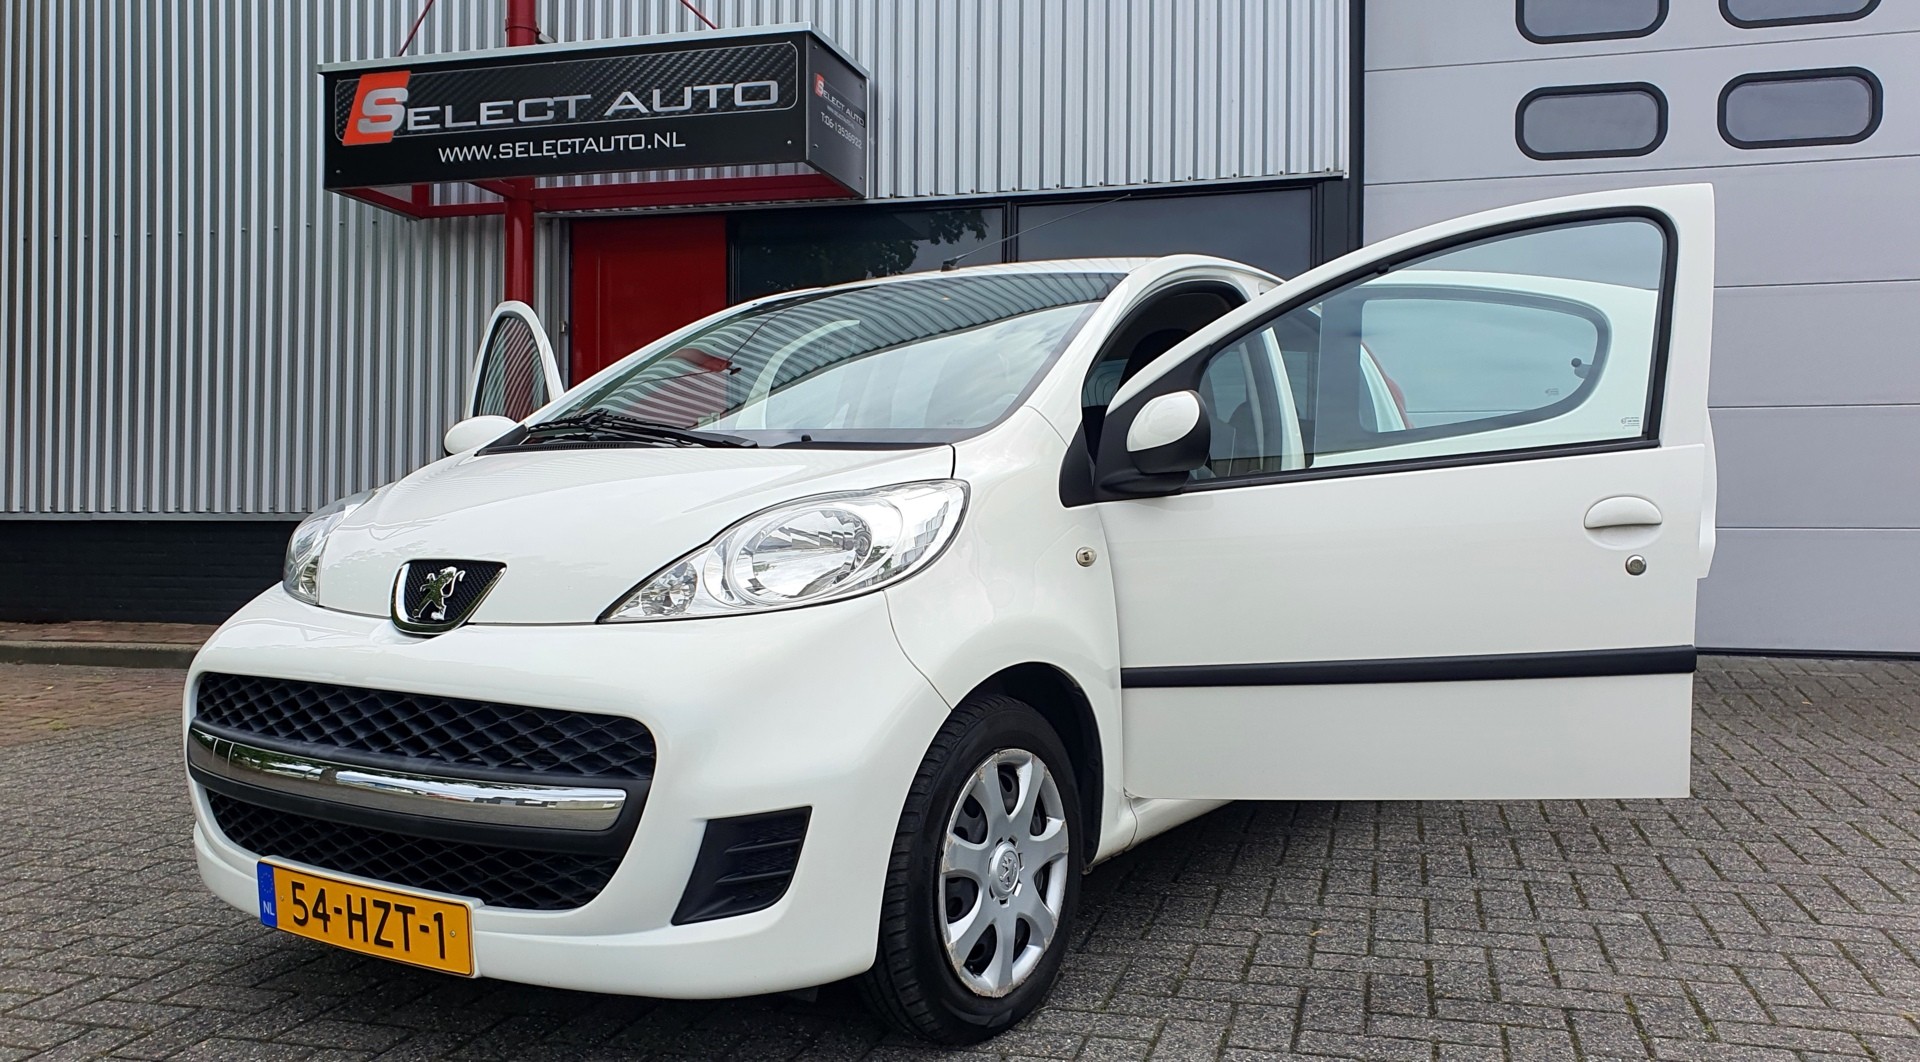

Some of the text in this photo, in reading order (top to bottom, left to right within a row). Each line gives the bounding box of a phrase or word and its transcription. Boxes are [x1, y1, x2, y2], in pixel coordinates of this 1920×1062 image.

[357, 86, 592, 134] SELECT
[603, 80, 779, 117] AUTO
[817, 80, 846, 111] SELECT
[846, 108, 865, 127] AUTO
[438, 132, 686, 163] WWW.SELECTAUTO.NL
[263, 901, 277, 917] NL
[291, 881, 446, 959] 54-HZT-1
